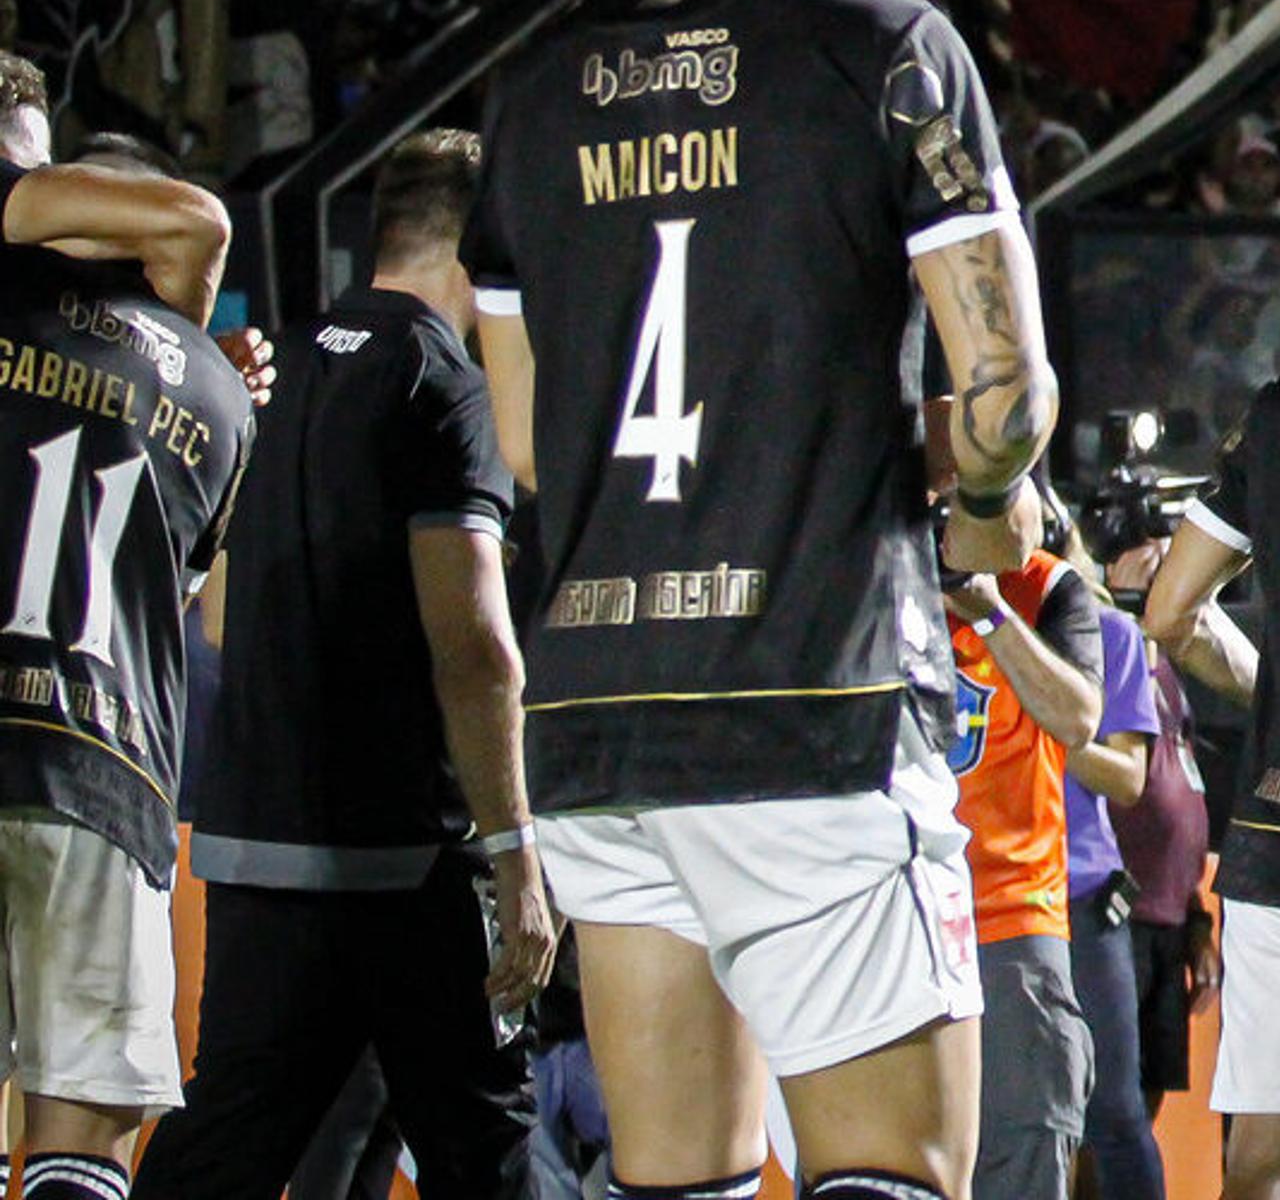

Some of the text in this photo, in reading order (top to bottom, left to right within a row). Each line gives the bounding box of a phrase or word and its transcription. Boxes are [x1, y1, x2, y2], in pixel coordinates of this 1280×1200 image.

[666, 28, 730, 50] VASCO
[578, 127, 739, 205] MAICON
[0, 338, 210, 467] GABRIEL PEC
[614, 218, 704, 502] 4
[0, 424, 150, 667] 11
